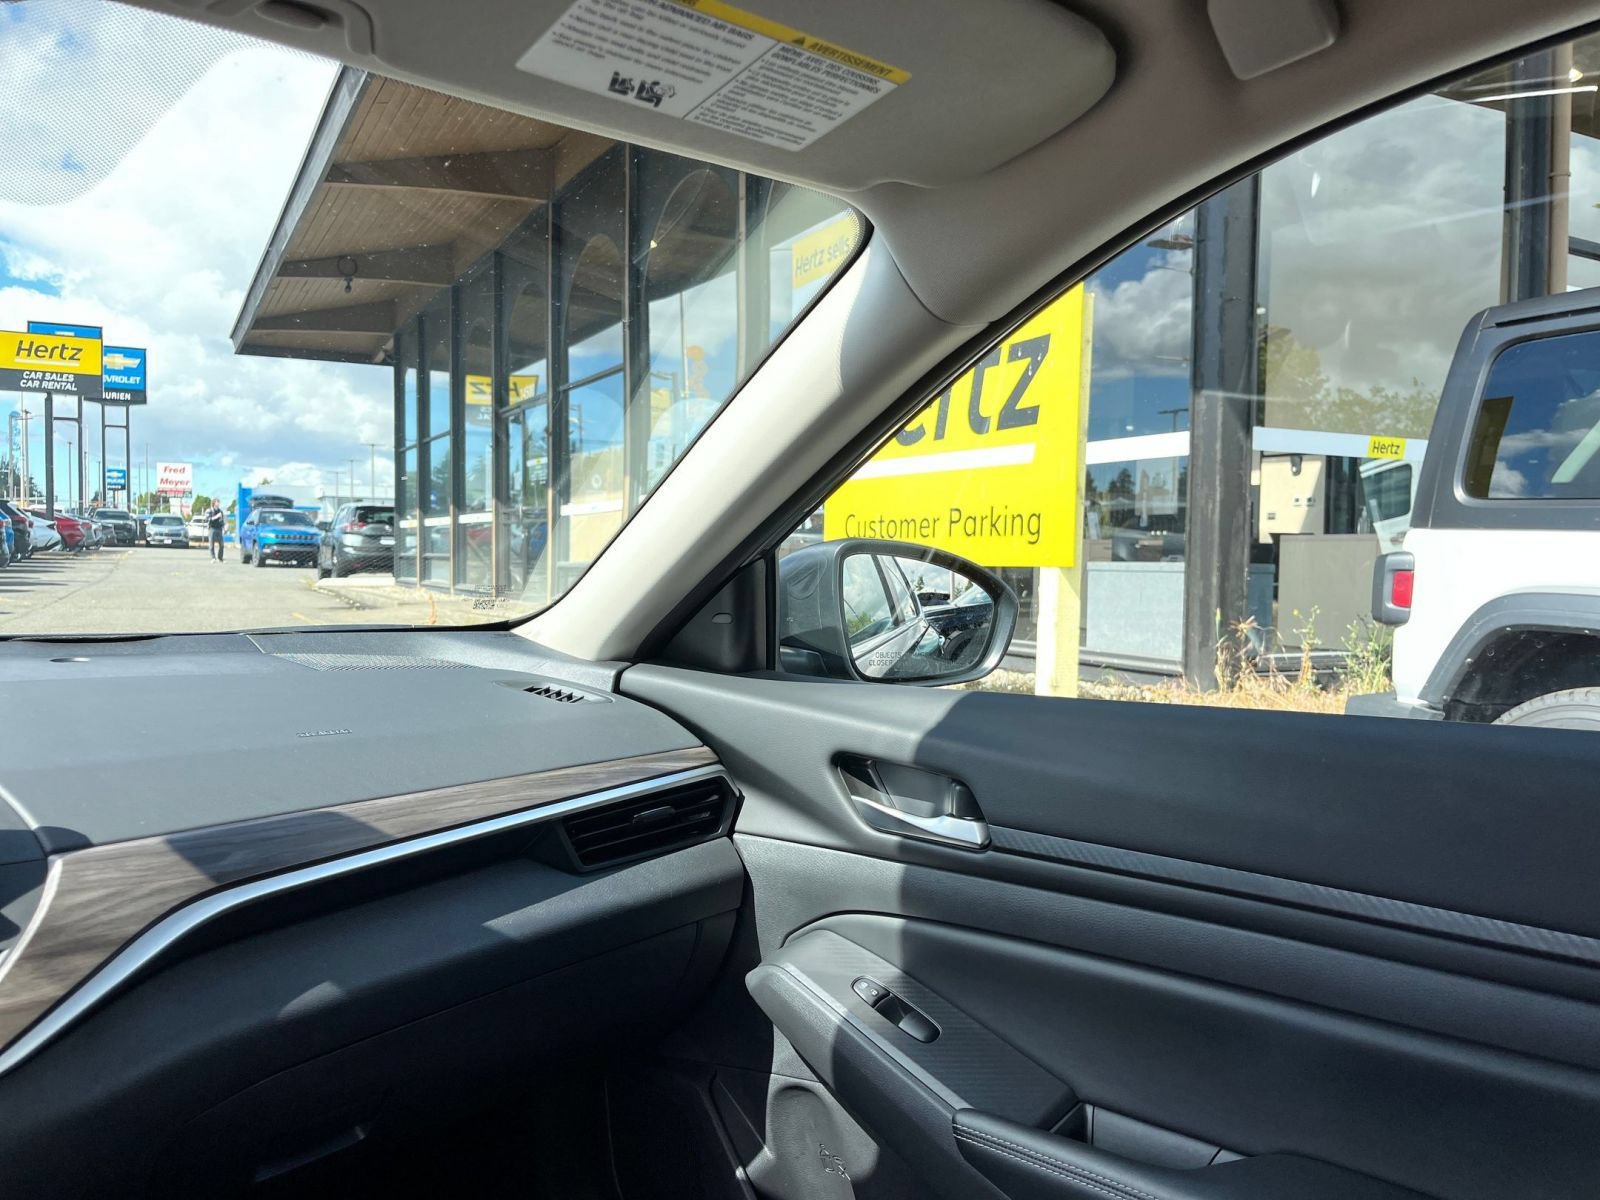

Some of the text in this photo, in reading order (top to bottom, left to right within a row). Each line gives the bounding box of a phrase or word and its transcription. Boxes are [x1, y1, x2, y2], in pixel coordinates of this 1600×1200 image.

[808, 42, 895, 77] AVERTISSEMENT
[794, 249, 825, 277] Hertz
[15, 339, 84, 361] Hertz
[23, 371, 74, 382] CAR SALES
[20, 380, 78, 391] CAR RENTAL
[1372, 440, 1400, 454] Hertz
[164, 466, 186, 474] Fred
[160, 478, 190, 487] Meyer
[845, 506, 1042, 545] Customer Parking
